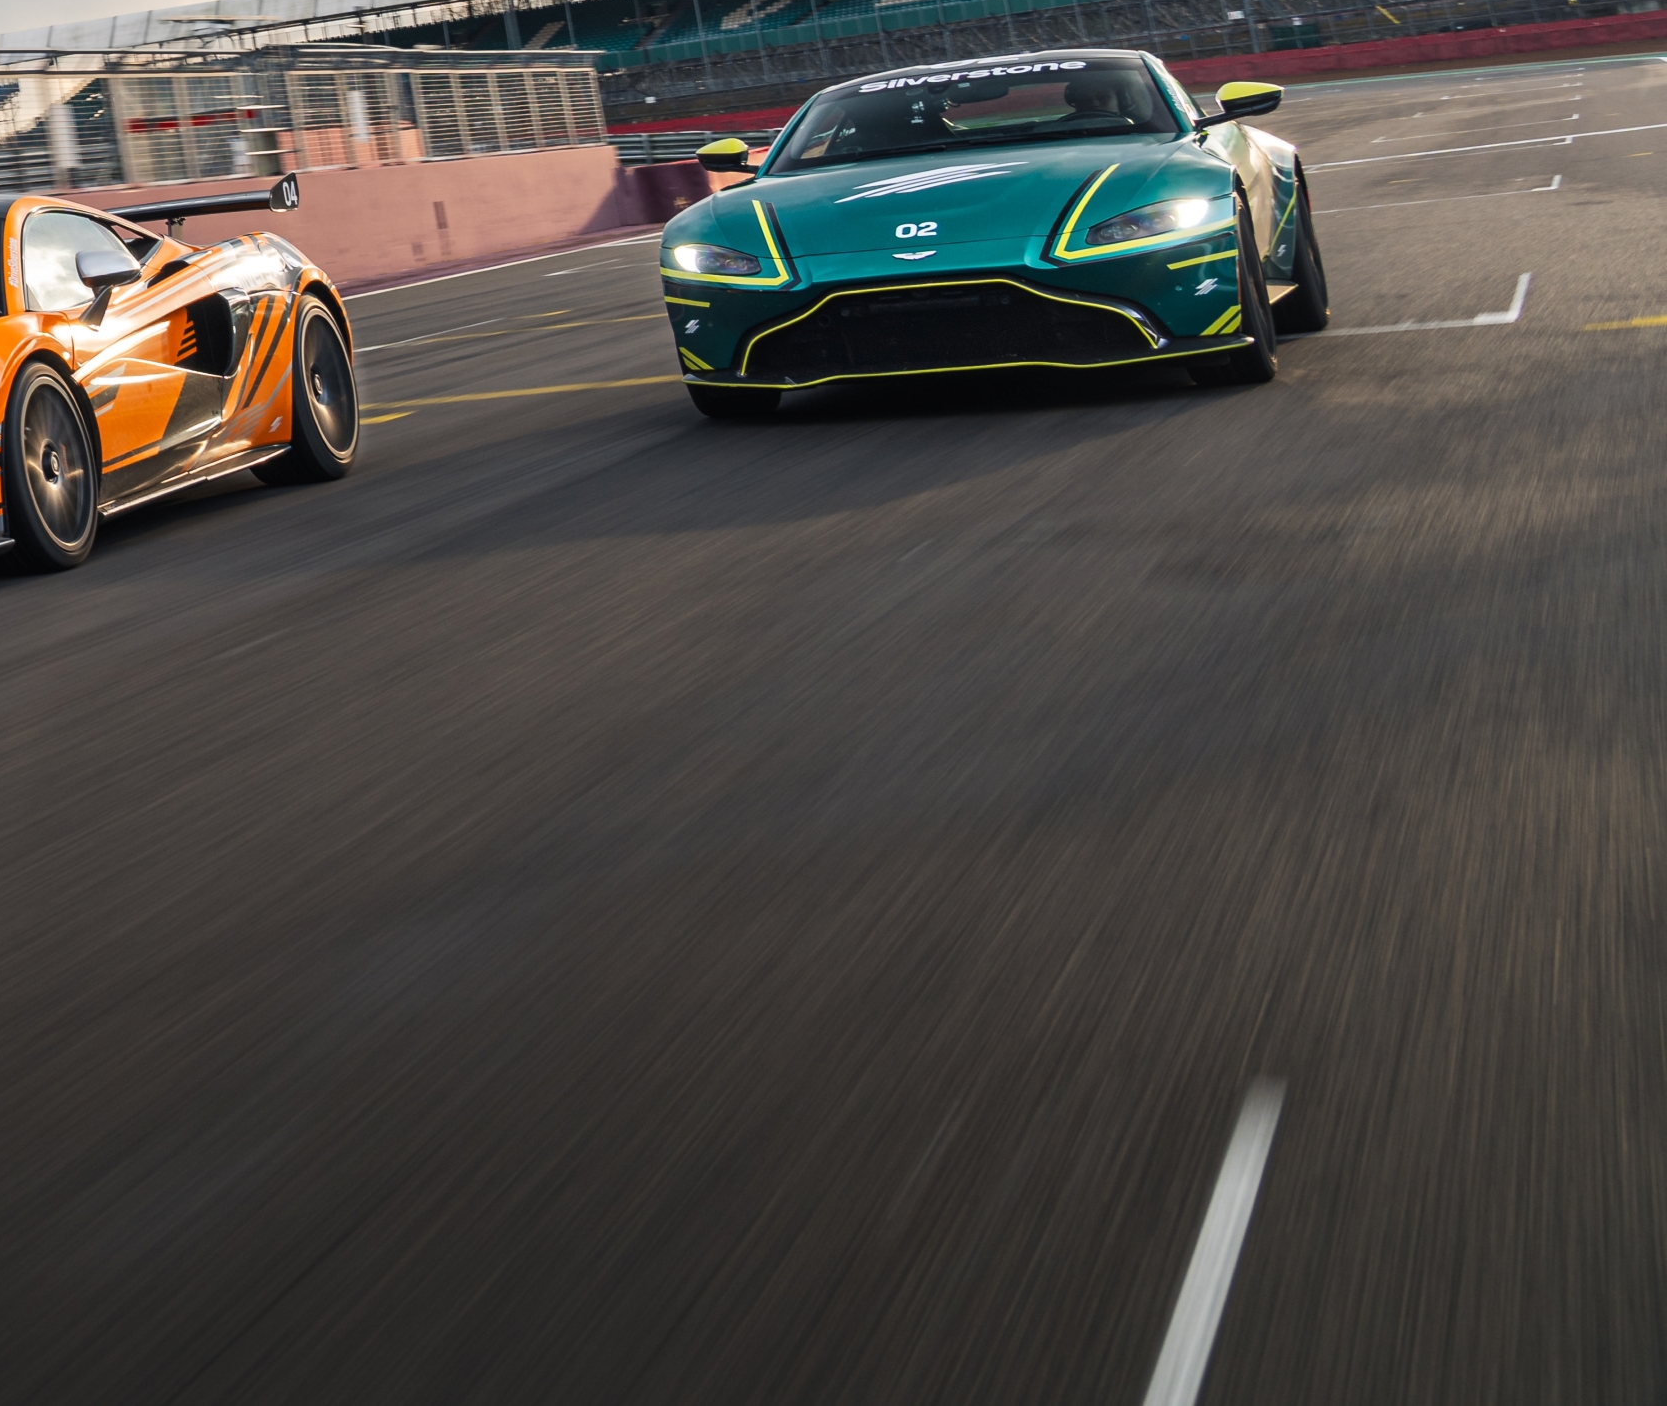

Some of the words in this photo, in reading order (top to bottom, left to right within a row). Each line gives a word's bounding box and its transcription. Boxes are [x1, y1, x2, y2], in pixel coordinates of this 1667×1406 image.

[858, 60, 1087, 93] Silverstone
[282, 181, 298, 206] 04
[895, 221, 938, 239] 02
